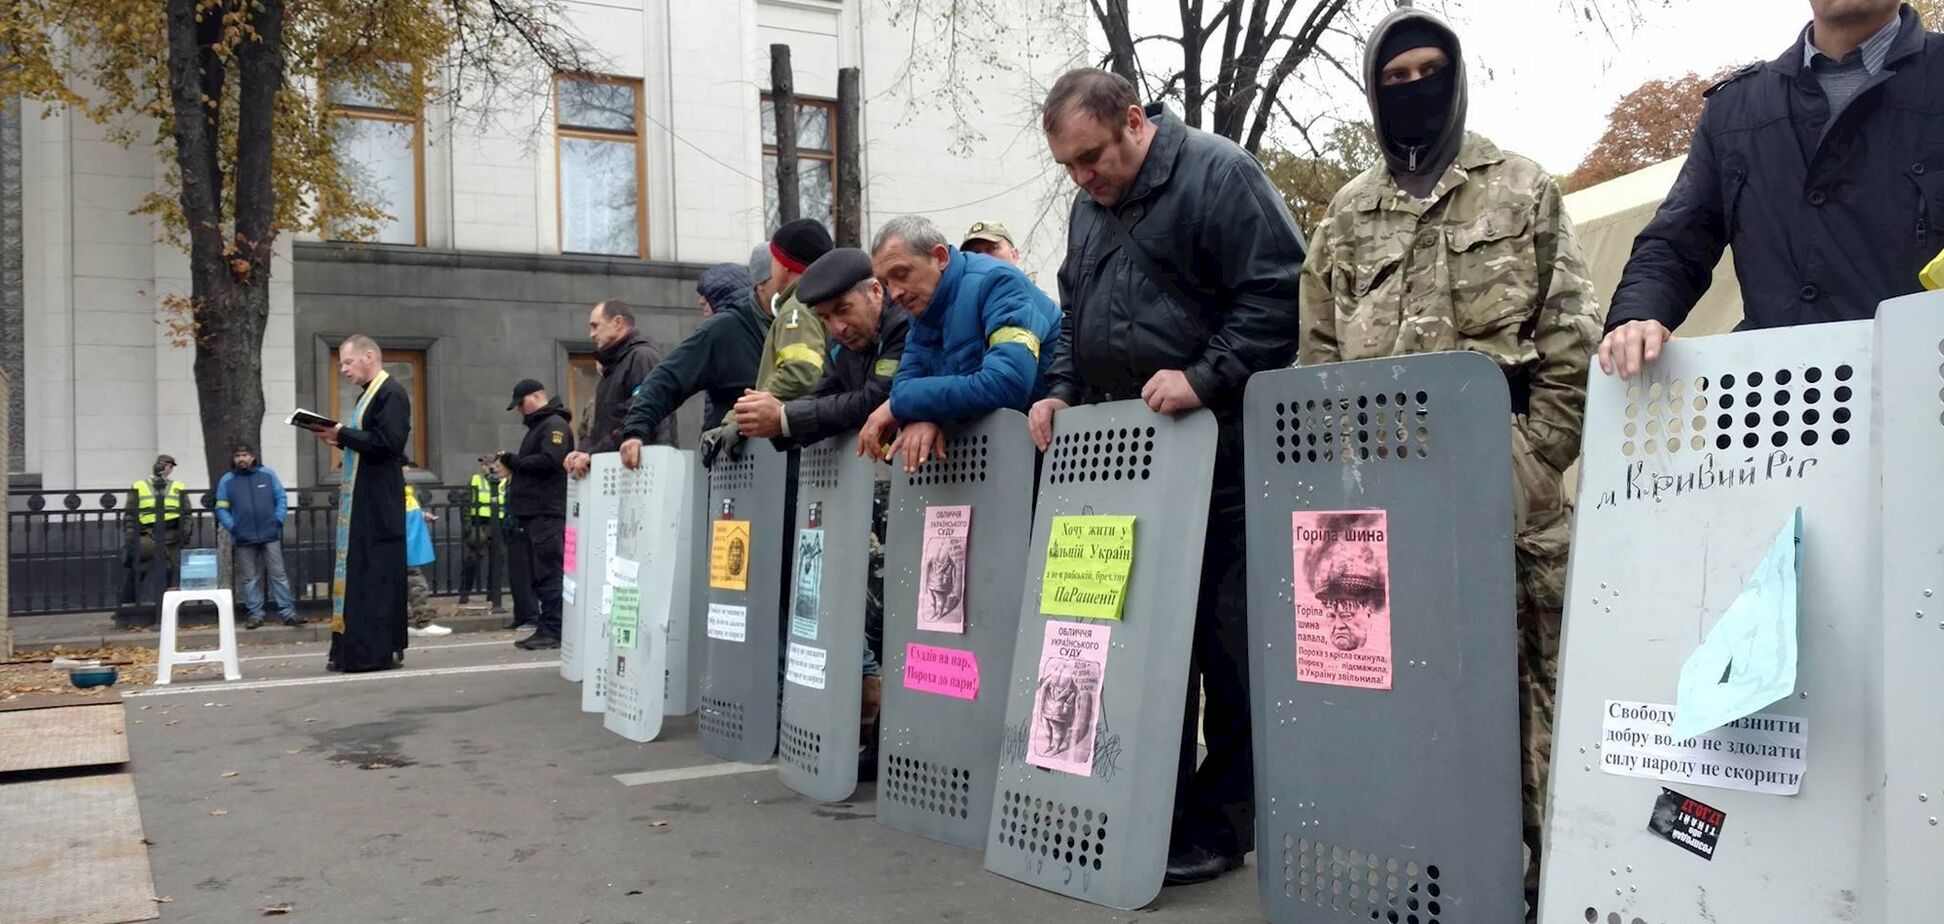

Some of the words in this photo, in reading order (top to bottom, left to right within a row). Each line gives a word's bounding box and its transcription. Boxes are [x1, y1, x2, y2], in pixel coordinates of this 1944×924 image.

[1626, 453, 1756, 500] Кривий
[1766, 450, 1818, 480] Ріг
[1062, 523, 1085, 539] Хочу
[1088, 526, 1116, 536] жити
[1296, 526, 1339, 545] Горіла
[1345, 529, 1384, 542] шина
[1297, 605, 1323, 617] Горіла
[1058, 627, 1092, 638] ОБЛИЧЧЯ
[1298, 621, 1320, 630] шина
[1051, 638, 1099, 650] УКРАЇНСЬКОГО
[939, 654, 949, 665] на
[1059, 647, 1082, 658] СУДУ
[1299, 647, 1323, 658] Пороха
[1330, 652, 1352, 660] крісла
[907, 666, 937, 684] Пороха
[950, 677, 976, 693] пари!
[1305, 668, 1336, 680] Україну
[1338, 672, 1384, 684] звільнила!
[1609, 702, 1676, 727] Свободу
[1606, 728, 1650, 748] добру
[1702, 738, 1722, 751] не
[1727, 739, 1801, 760] здолати
[1605, 752, 1639, 770] силу
[1642, 755, 1696, 778] народу
[1701, 763, 1720, 776] не
[1724, 767, 1800, 786] скорити
